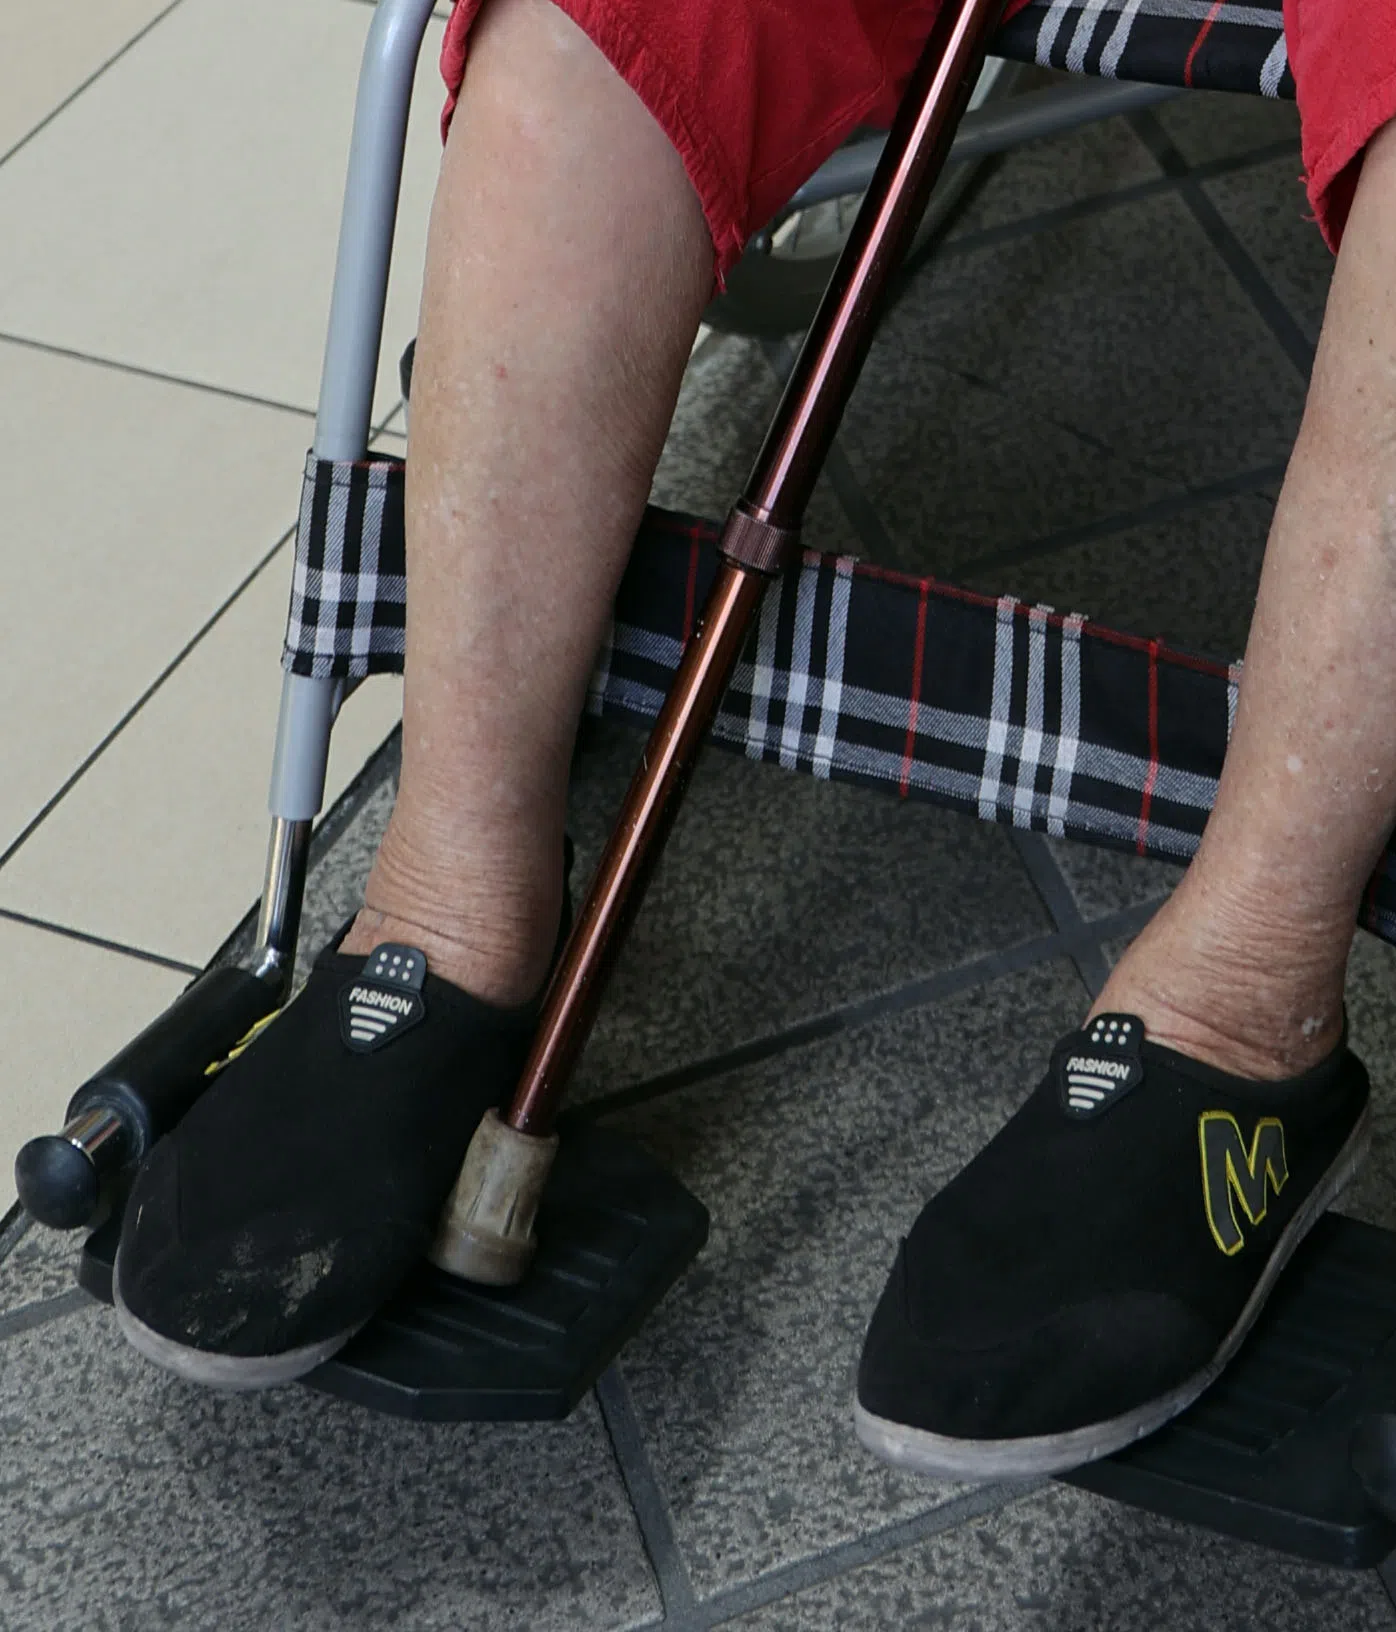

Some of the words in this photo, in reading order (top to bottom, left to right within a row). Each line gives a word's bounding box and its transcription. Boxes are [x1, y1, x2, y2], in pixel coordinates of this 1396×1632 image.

[349, 986, 413, 1016] FASHION
[1066, 1057, 1130, 1080] FASHION
[1199, 1109, 1289, 1256] M
